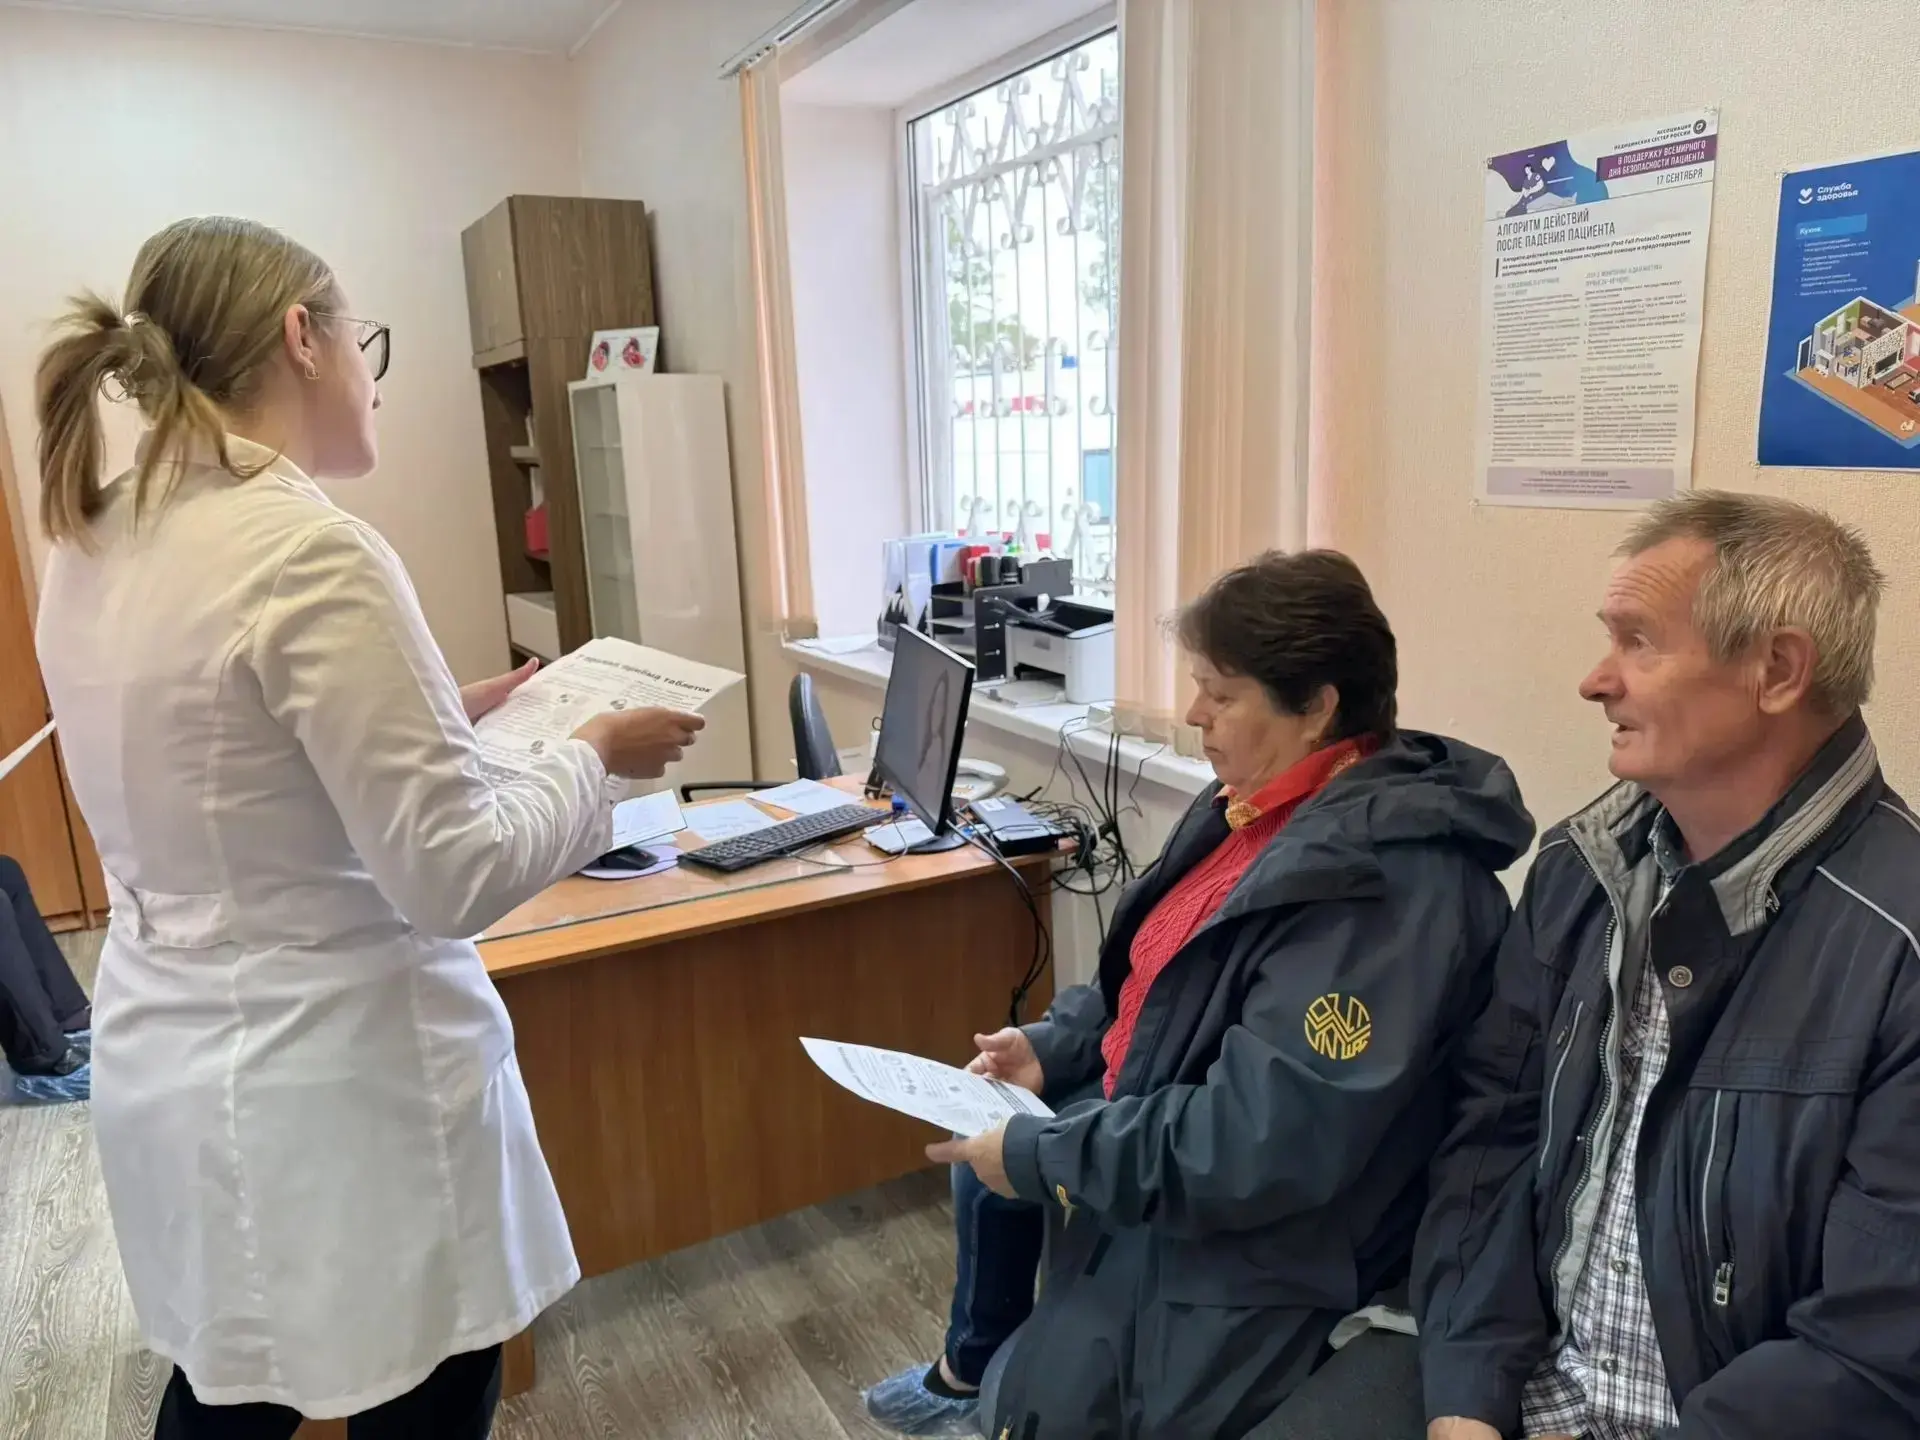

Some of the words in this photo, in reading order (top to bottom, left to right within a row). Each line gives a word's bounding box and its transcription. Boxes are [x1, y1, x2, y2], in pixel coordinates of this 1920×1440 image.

[1657, 124, 1692, 135] АССОЦИАЦИЯ
[1624, 150, 1662, 164] ПОДДЕРЖКУ
[1664, 140, 1706, 156] ВСЕМИРНОГО
[1608, 167, 1621, 178] ДНЯ
[1622, 158, 1670, 175] БЕЗОПАСНОСТИ
[1671, 151, 1705, 166] ПАЦИЕНТА
[1656, 176, 1664, 185] 17
[1666, 168, 1703, 184] СЕНТЯБРЯ
[1816, 190, 1859, 202] здоровья
[1817, 182, 1852, 194] Служба
[1497, 218, 1541, 237] АЛГОРИТМ
[1543, 208, 1589, 230] ДЕЙСТВИЙ
[1496, 237, 1522, 252] ПОСЛЕ
[1525, 230, 1566, 247] ПАДЕНИЯ
[1568, 222, 1616, 241] ПАЦИЕНТА
[664, 677, 712, 693] таблеток
